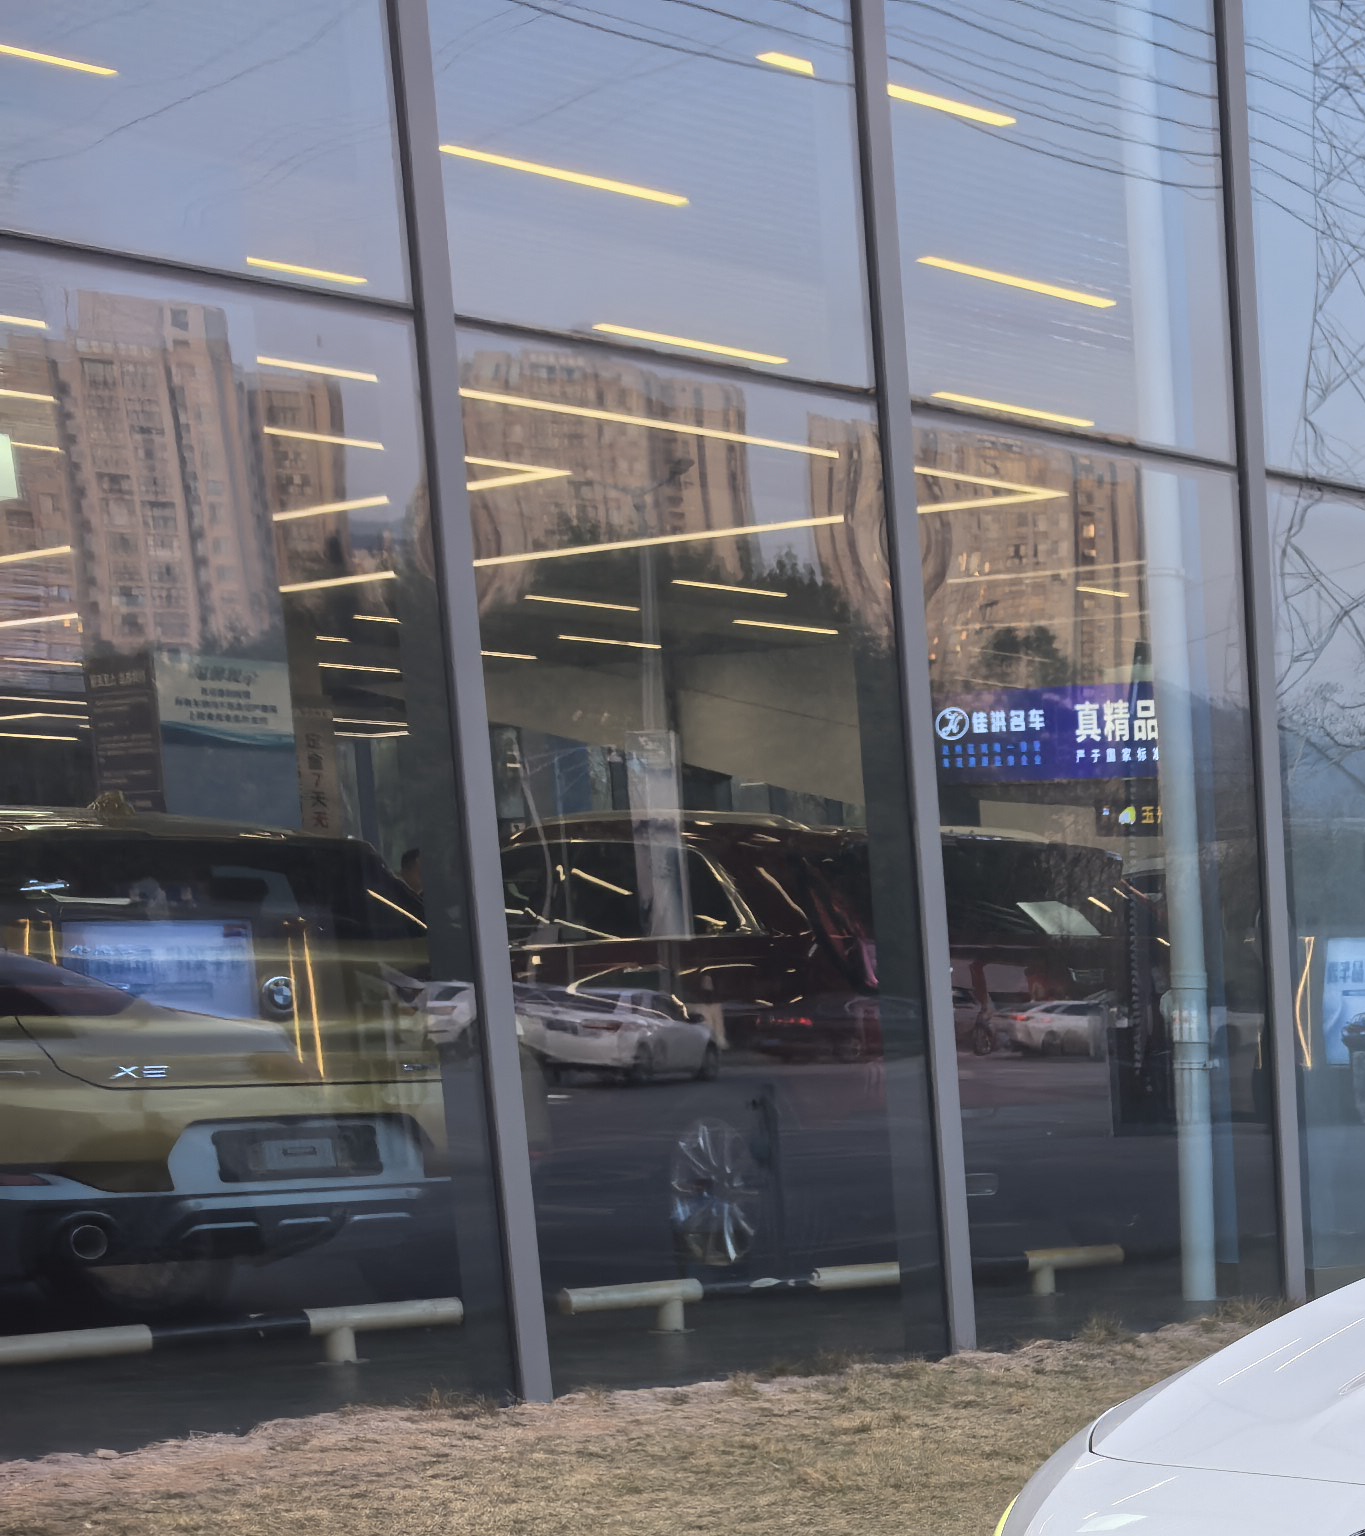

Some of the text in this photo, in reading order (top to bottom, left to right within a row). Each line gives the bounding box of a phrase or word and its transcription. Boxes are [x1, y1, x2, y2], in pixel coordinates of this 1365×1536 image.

[972, 708, 1046, 733] 佳洪名车
[1074, 699, 1158, 743] 真精品
